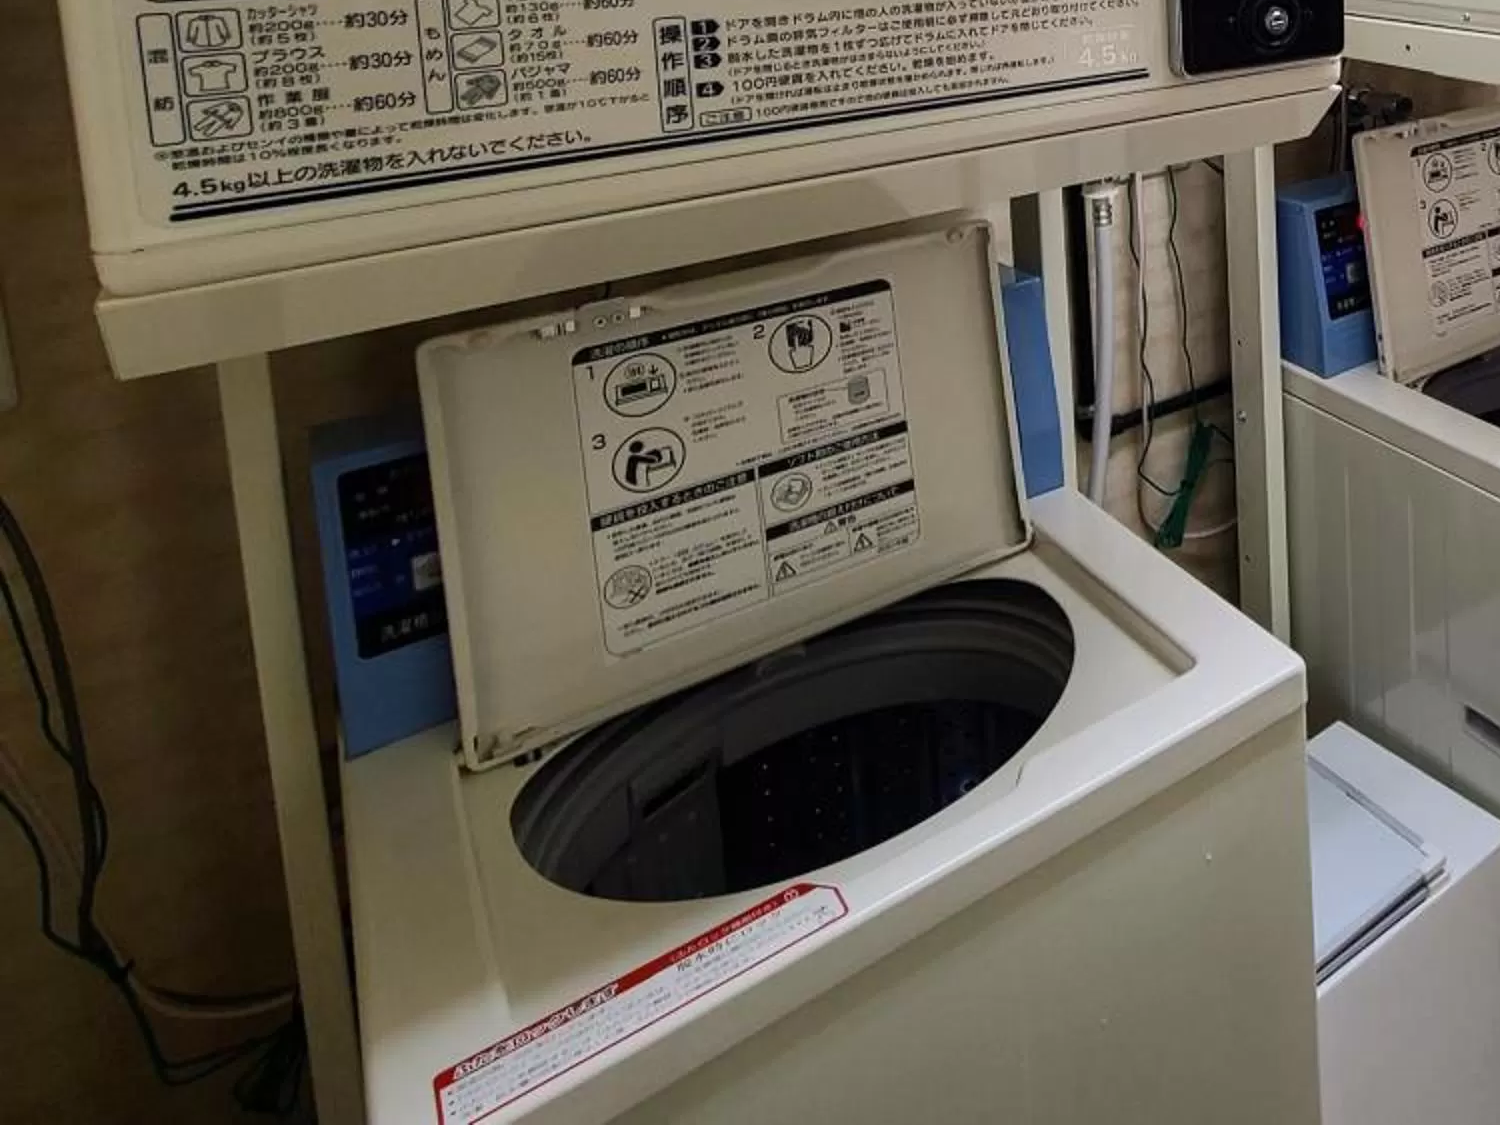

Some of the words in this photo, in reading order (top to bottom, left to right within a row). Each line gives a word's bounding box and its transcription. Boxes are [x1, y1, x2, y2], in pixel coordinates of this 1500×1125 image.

[344, 9, 409, 28] 約30分
[508, 26, 567, 41] タオル
[587, 30, 639, 48] 約60分
[251, 46, 326, 64] ブラウス
[349, 50, 413, 71] 約30分
[511, 62, 571, 79] パジャマ
[590, 67, 641, 86] 約60分
[659, 25, 689, 124] 操作順序
[353, 91, 417, 113] 約60分
[172, 129, 592, 198] 4.5kg以上の洗濯物を入れないでください。
[752, 325, 766, 340] 2
[591, 433, 607, 450] 3
